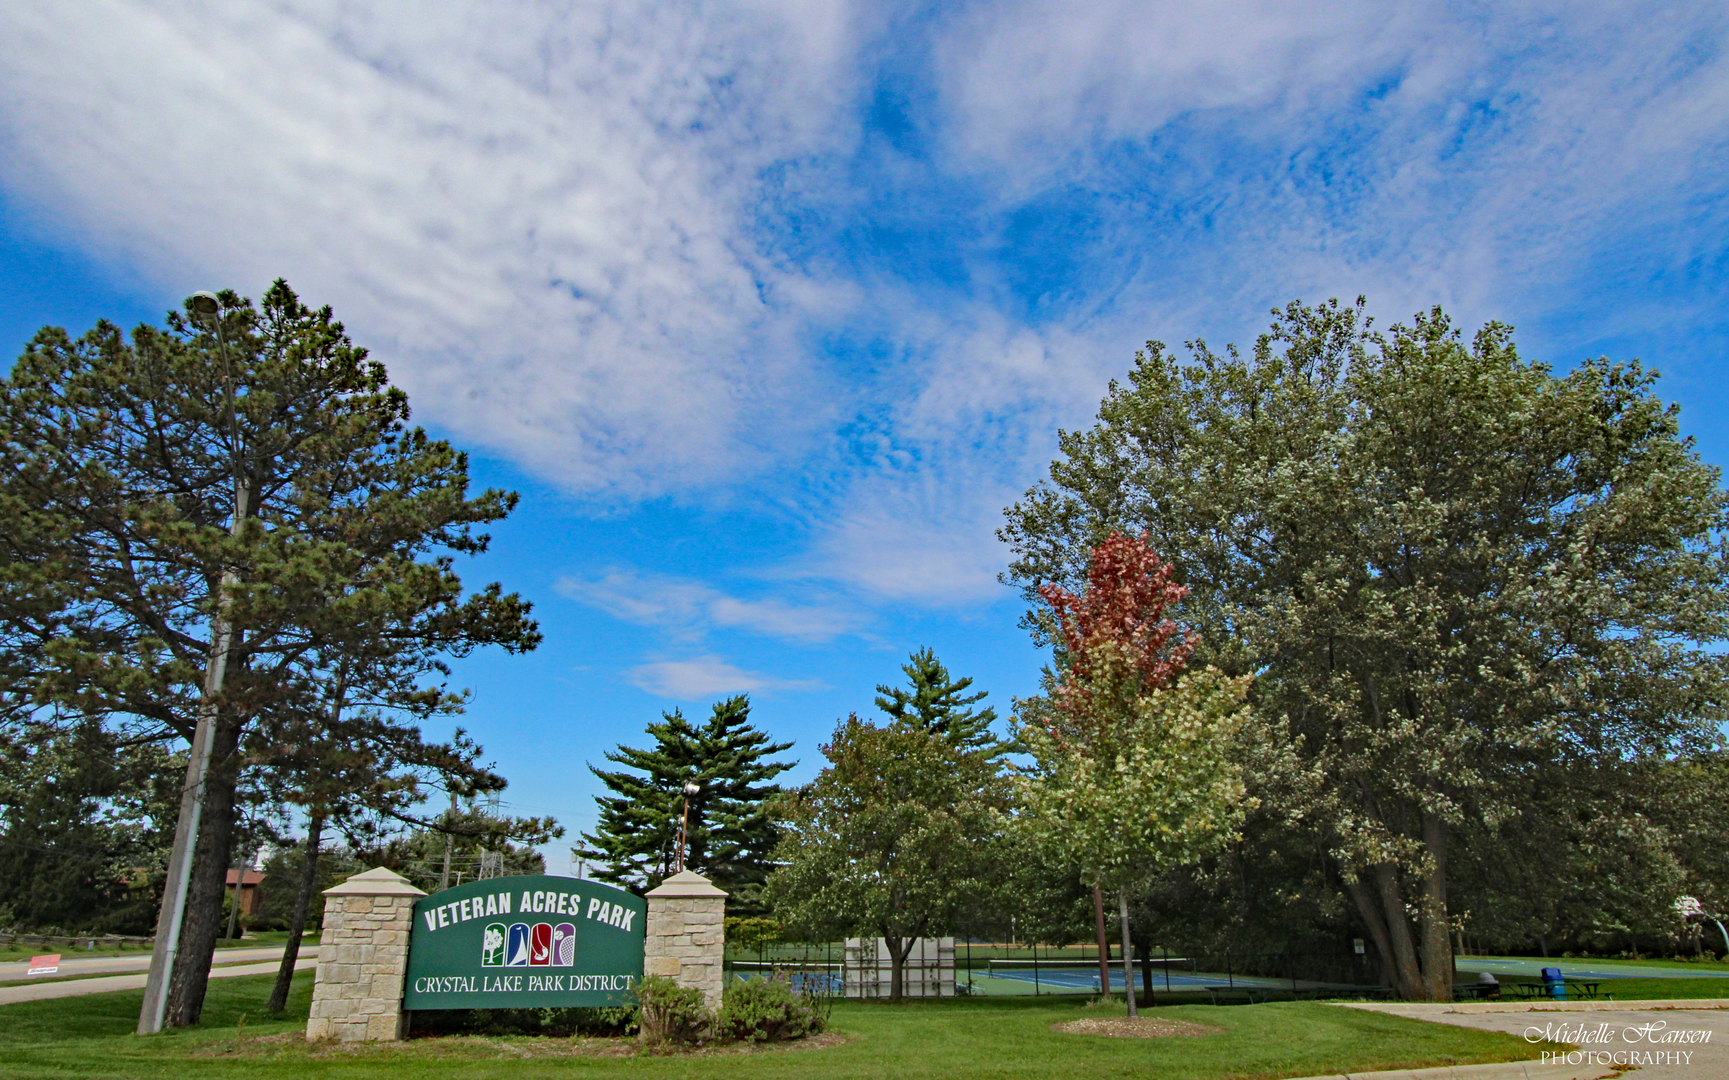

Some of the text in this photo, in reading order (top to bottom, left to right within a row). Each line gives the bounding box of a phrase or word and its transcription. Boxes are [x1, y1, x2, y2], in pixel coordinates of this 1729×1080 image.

[424, 890, 637, 932] VETERAN ACRES PARK
[414, 974, 634, 993] CRYSTAL LAKE PARK DISTRICT
